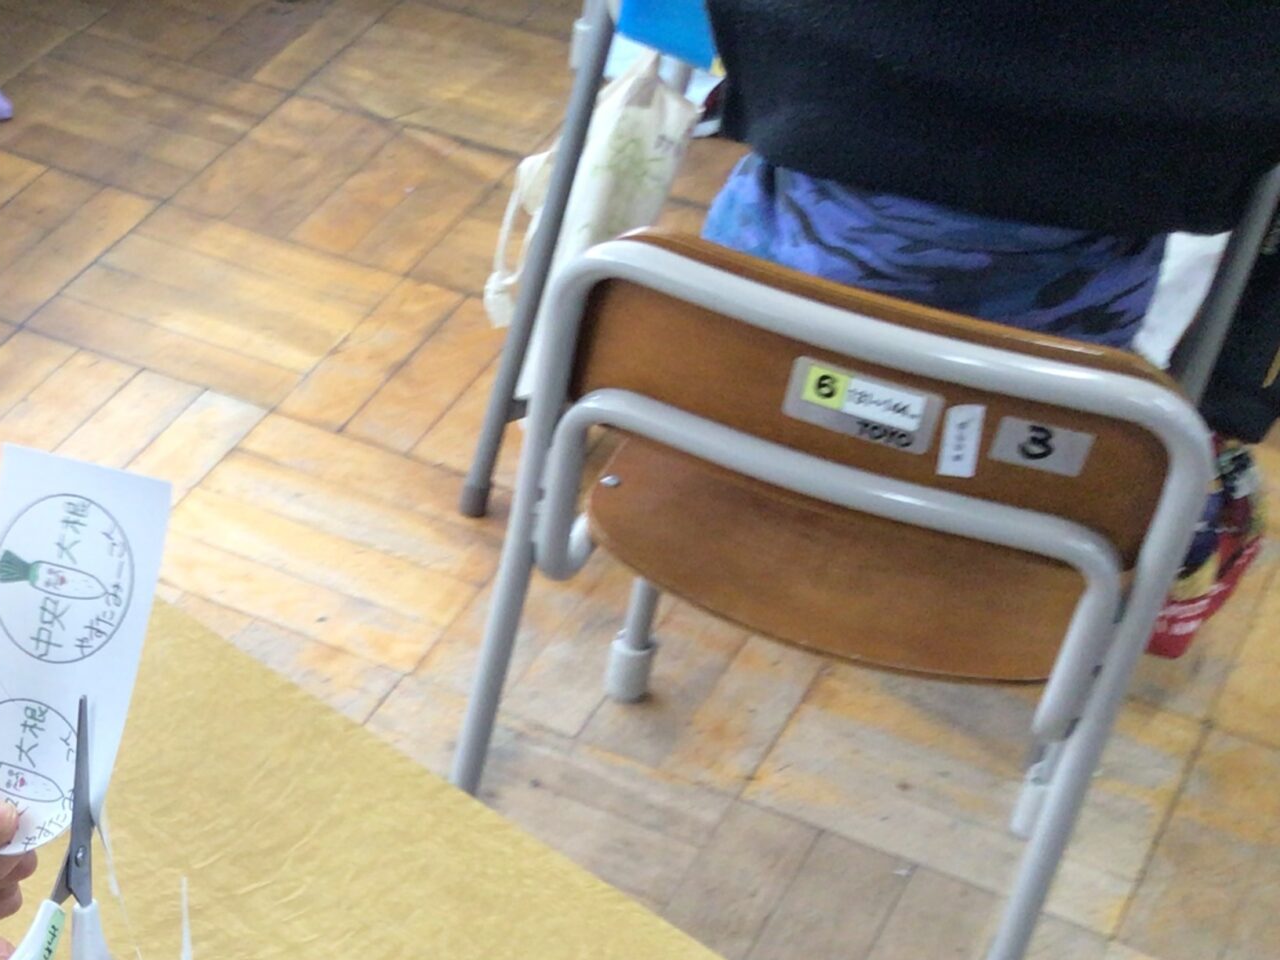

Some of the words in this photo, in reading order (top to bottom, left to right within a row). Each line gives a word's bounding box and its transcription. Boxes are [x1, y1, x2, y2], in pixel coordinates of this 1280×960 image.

[1018, 424, 1055, 460] 3
[55, 501, 93, 565] 大根
[29, 596, 71, 659] 中央
[14, 705, 50, 768] 大根
